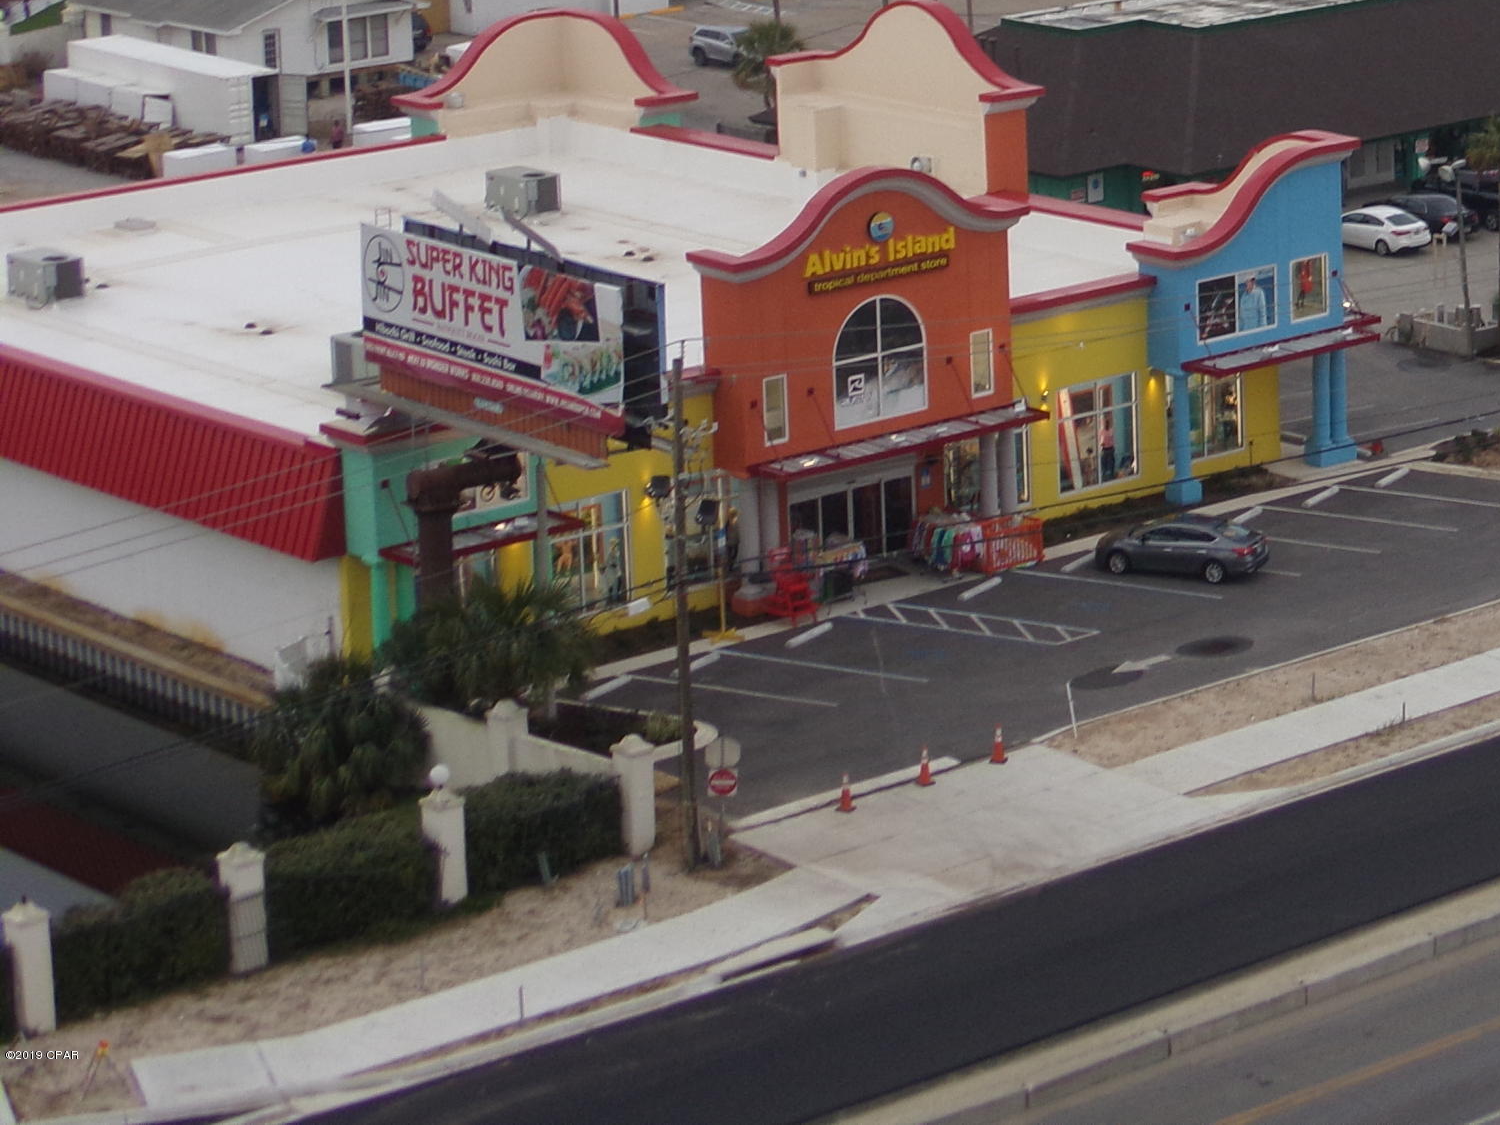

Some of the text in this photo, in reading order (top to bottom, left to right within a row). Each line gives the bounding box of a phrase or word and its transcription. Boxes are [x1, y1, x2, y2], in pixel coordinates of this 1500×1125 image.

[405, 239, 515, 296] SUPER KING
[804, 226, 956, 278] Alvin's Island
[814, 256, 948, 292] tropical department store
[411, 273, 509, 339] BUFFET
[421, 334, 450, 354] Seafood
